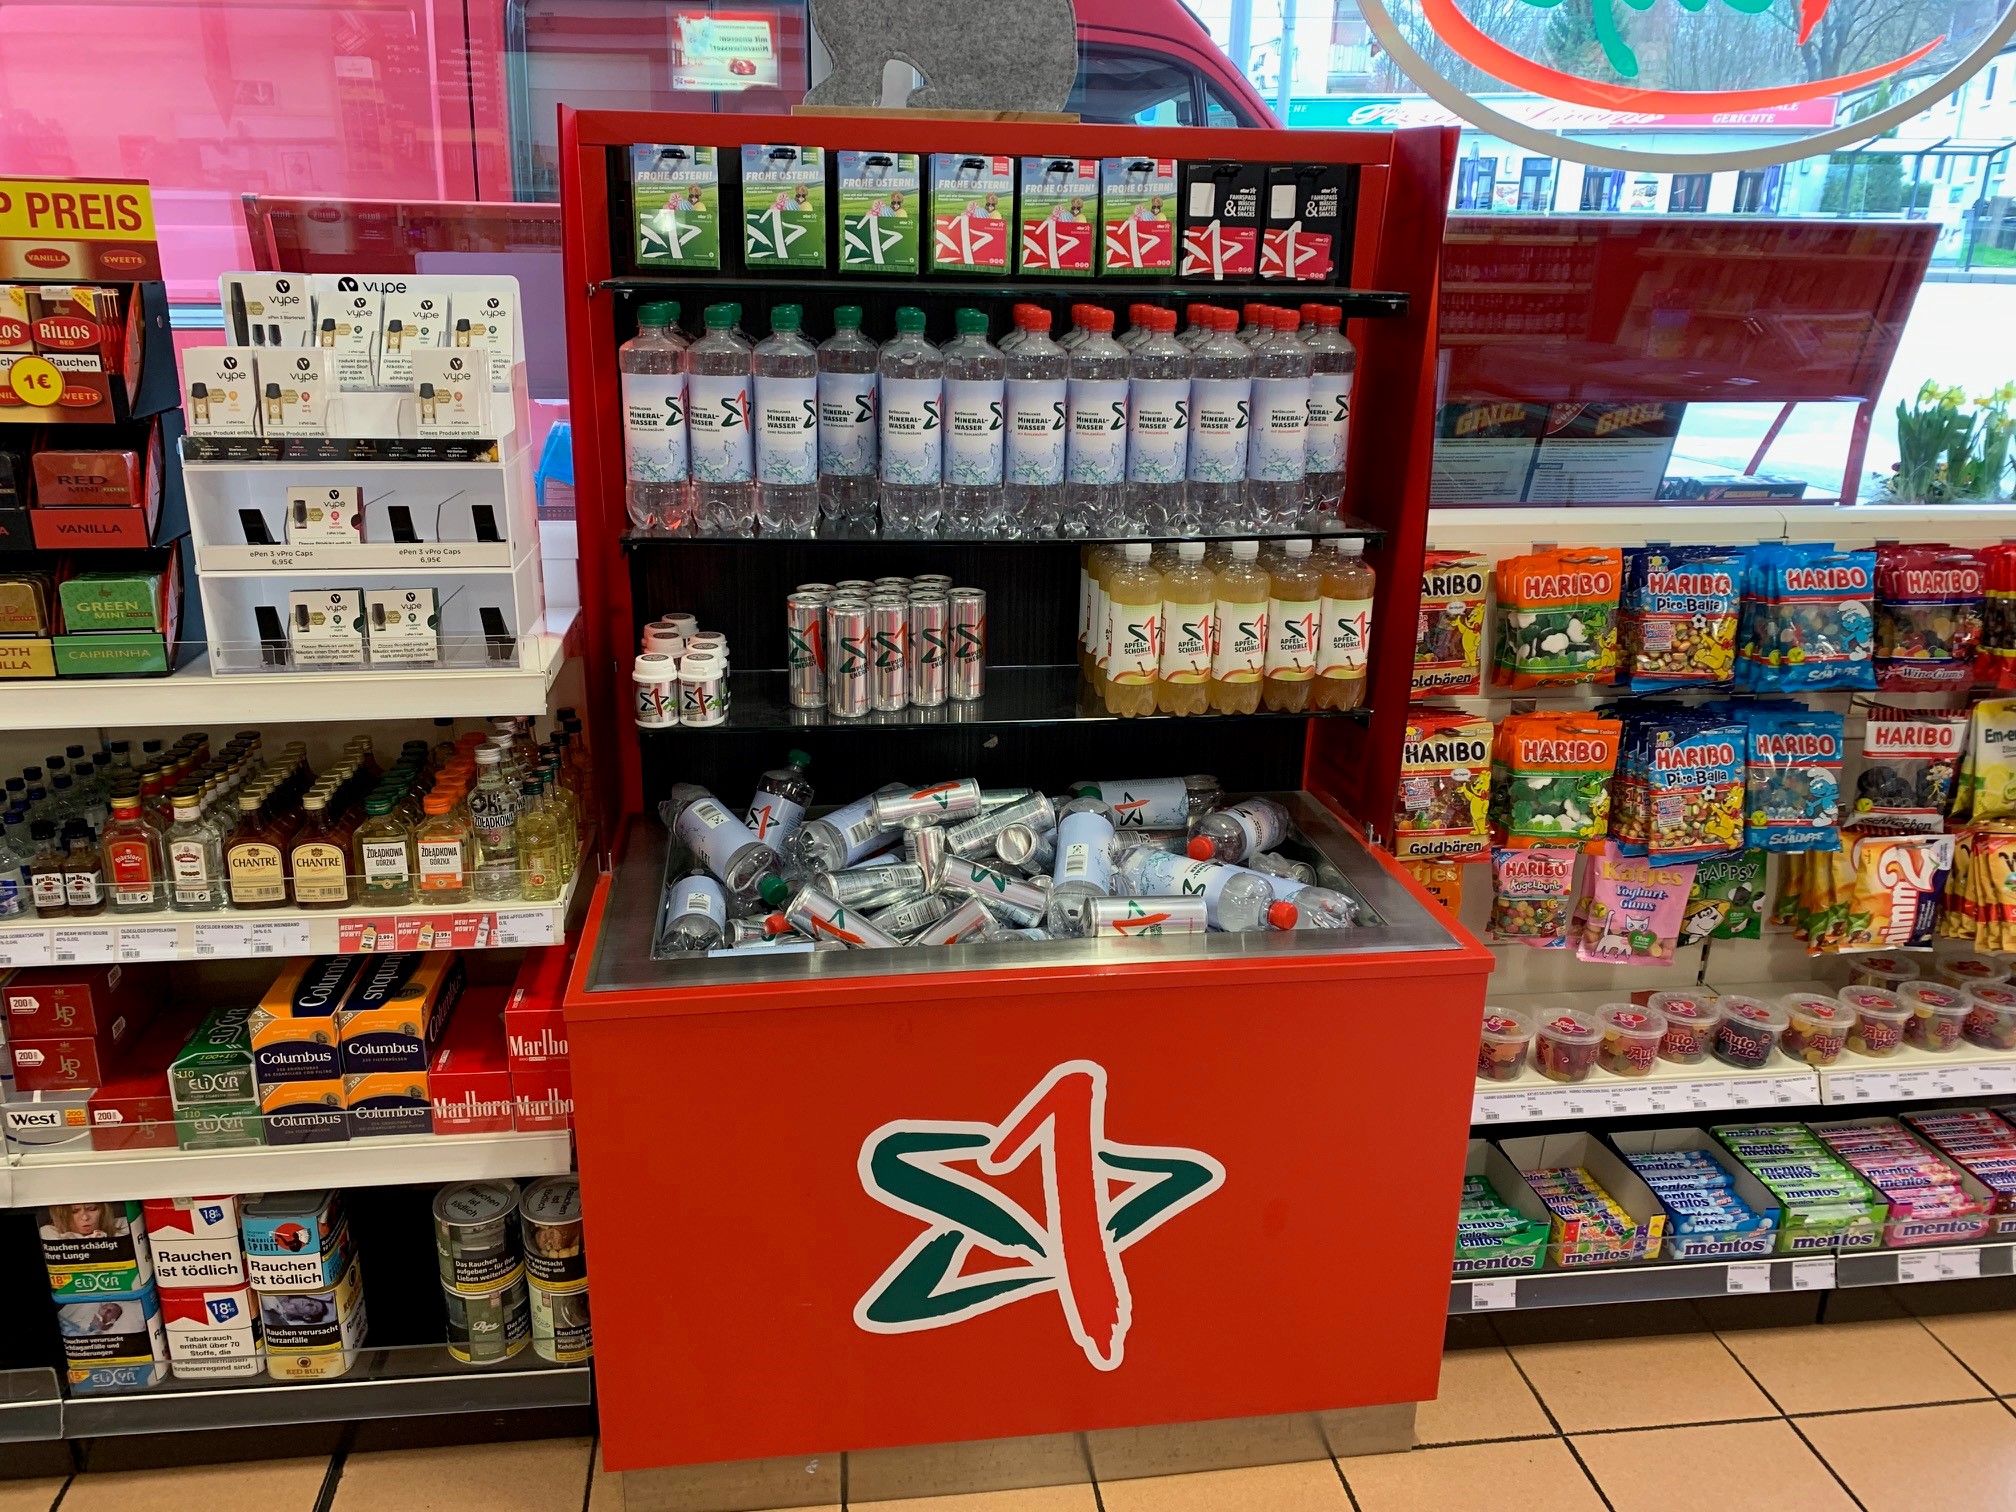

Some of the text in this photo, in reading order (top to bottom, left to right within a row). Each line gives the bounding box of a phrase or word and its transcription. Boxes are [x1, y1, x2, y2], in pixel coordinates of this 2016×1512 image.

[1712, 112, 1775, 124] GERICHTE
[638, 171, 712, 181] FROHE OSTERN!
[746, 171, 819, 181] FROHE OSTERN!
[843, 178, 914, 188] FROHE OSTERN!
[938, 180, 1009, 189] FROHE OSTERN!
[1025, 184, 1095, 194] FROHE OSTERN!
[1107, 183, 1173, 194] FROHE OSTERN!
[25, 192, 142, 231] PREIS
[28, 253, 68, 262] VANILLA
[104, 255, 143, 263] SWEETS
[362, 282, 407, 295] vype
[269, 296, 300, 306] vype
[346, 309, 373, 318] vype
[413, 311, 439, 319] vype
[480, 310, 506, 318] vype
[23, 374, 51, 390] 1€
[217, 372, 246, 382] vype
[289, 372, 319, 383] vype
[443, 372, 471, 382] vype
[691, 419, 714, 427] WASSER
[888, 422, 915, 430] WASSER
[57, 475, 107, 485] RED
[324, 500, 345, 509] vype
[57, 524, 122, 534] VANILLA
[1649, 573, 1732, 595] HARIBO
[1787, 567, 1866, 589] HARIBO
[1907, 570, 1978, 594] HARIBO
[1525, 573, 1611, 598] HARIBO
[76, 601, 138, 612] GREEN
[325, 605, 348, 613] vype
[401, 604, 422, 612] vype
[1124, 641, 1146, 649] APFEL-
[69, 649, 151, 660] CAIPIRINHA
[1903, 669, 1965, 679] Wine Gums
[1876, 727, 1953, 746] HARIBO
[1757, 734, 1835, 755] HARIBO
[1405, 741, 1485, 763] HARIBO
[1523, 740, 1607, 763] HARIBO
[1656, 744, 1735, 770] HARIBO
[1410, 840, 1482, 855] Goldbären
[233, 855, 278, 868] CHANTRÉ
[296, 855, 340, 868] CHANTRÉ
[1505, 861, 1568, 877] HARIBO
[1602, 861, 1683, 887] Katjes
[1698, 863, 1760, 884] TAPPSY
[1510, 880, 1562, 893] Kugelbunt
[1616, 885, 1669, 900] Yoghurt-
[1619, 900, 1656, 912] Gums
[13, 999, 28, 1008] 200
[340, 1012, 353, 1024] 250
[252, 1021, 264, 1034] 250
[1861, 1026, 1899, 1039] Auto
[1721, 1026, 1756, 1049] Auto
[348, 1043, 418, 1055] Columbus
[1667, 1042, 1701, 1054] pack
[1728, 1043, 1764, 1059] pack
[19, 1051, 33, 1060] 200
[260, 1052, 332, 1065] Columbus
[262, 1084, 275, 1096] 250
[433, 1090, 511, 1119] Marlboro
[11, 1112, 57, 1125] West
[97, 1112, 112, 1120] 200
[355, 1106, 425, 1119] Columbus
[270, 1114, 341, 1128] Columbus
[467, 1186, 500, 1208] Rauchen
[1786, 1187, 1840, 1198] mentos
[450, 1200, 478, 1218] tödlich
[1903, 1219, 1982, 1236] mentos
[43, 1241, 118, 1252] Rauchen schädigt
[248, 1243, 279, 1252] SPIRIT
[1685, 1238, 1767, 1256] mentos
[1793, 1233, 1874, 1250] mentos
[45, 1252, 90, 1261] Ihre Lunge
[158, 1251, 232, 1263] Rauchen
[469, 1258, 498, 1267] Rauchen
[1565, 1249, 1630, 1264] mentos
[157, 1264, 238, 1277] ist tödlich
[251, 1260, 317, 1272] Rauchen
[457, 1262, 516, 1282] Lieben weiterleben
[250, 1273, 322, 1285] ist tödlich
[266, 1325, 339, 1336] Rauchen verursacht
[180, 1342, 208, 1350] enthält
[267, 1336, 309, 1344] Herzanfälle
[190, 1349, 217, 1357] Stoffe,
[233, 1363, 254, 1371] sind.
